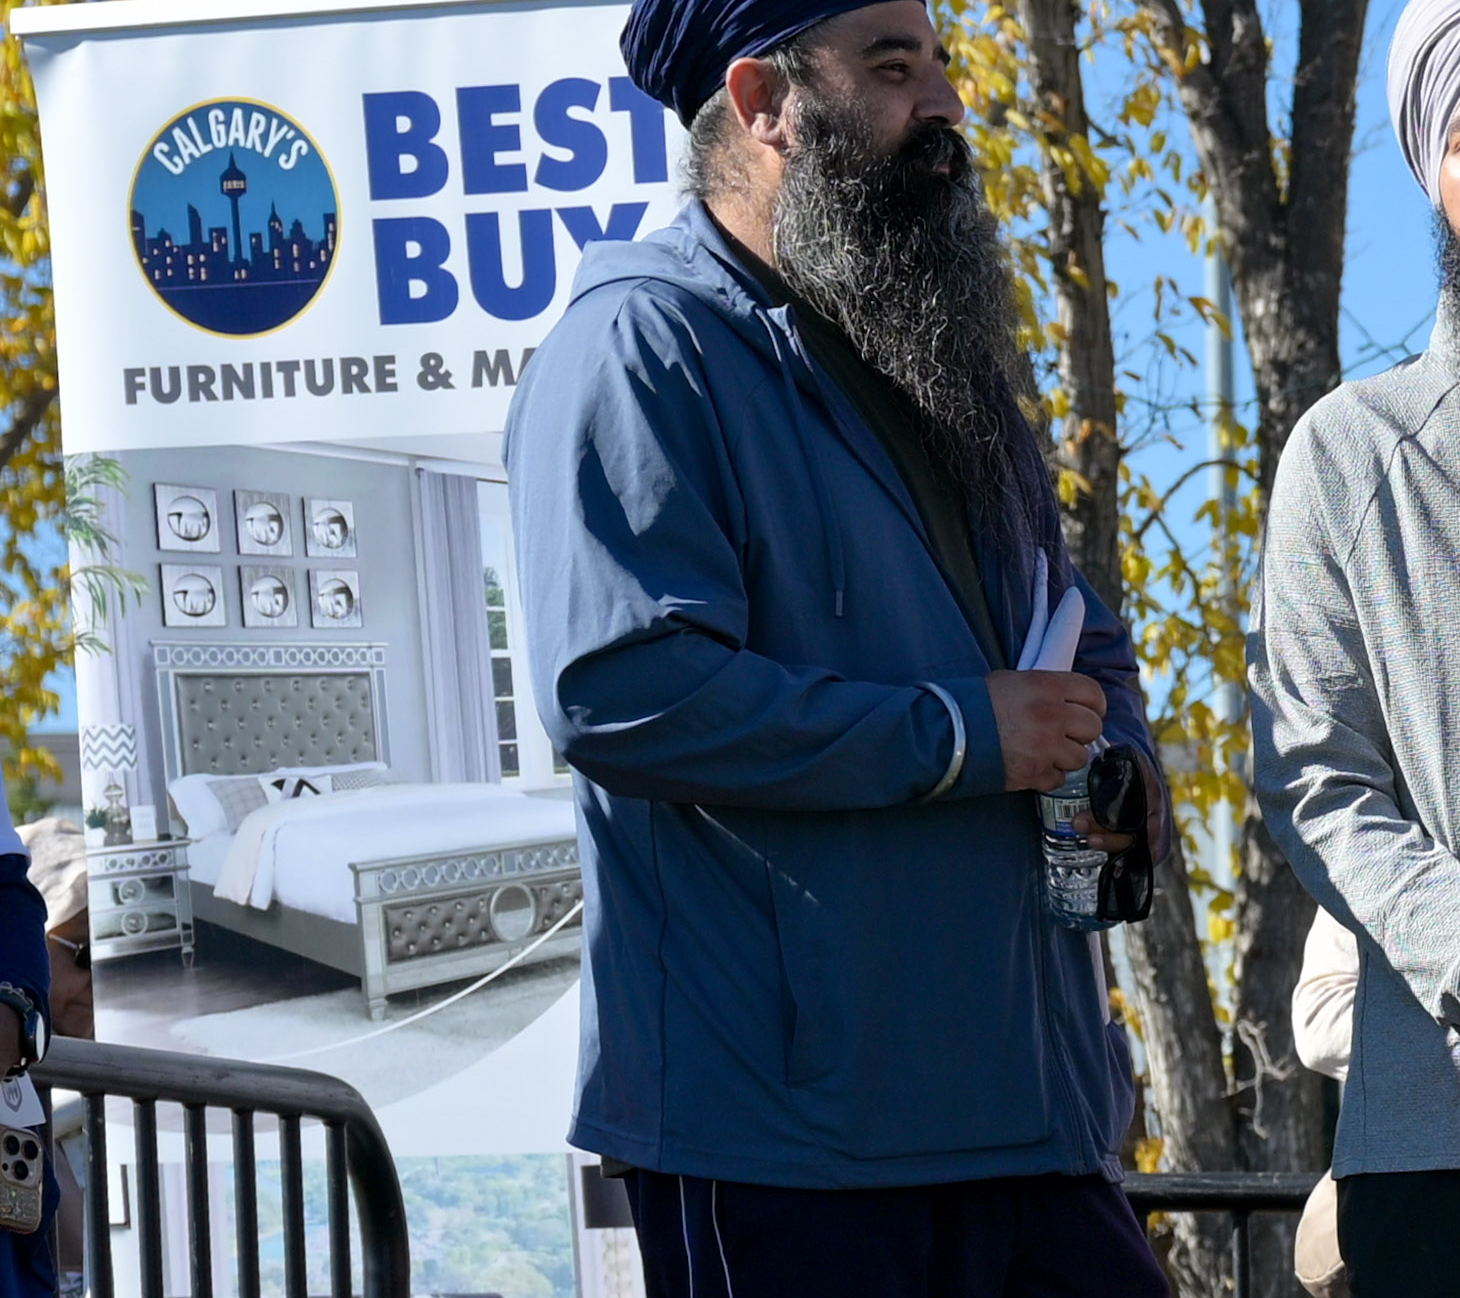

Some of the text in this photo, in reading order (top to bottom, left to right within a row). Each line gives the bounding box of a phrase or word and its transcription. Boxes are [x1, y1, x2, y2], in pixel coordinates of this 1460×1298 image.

[153, 107, 309, 176] CALGARY'S
[362, 76, 669, 200] BEST
[123, 354, 398, 406] FURNITURE
[416, 352, 455, 392] &
